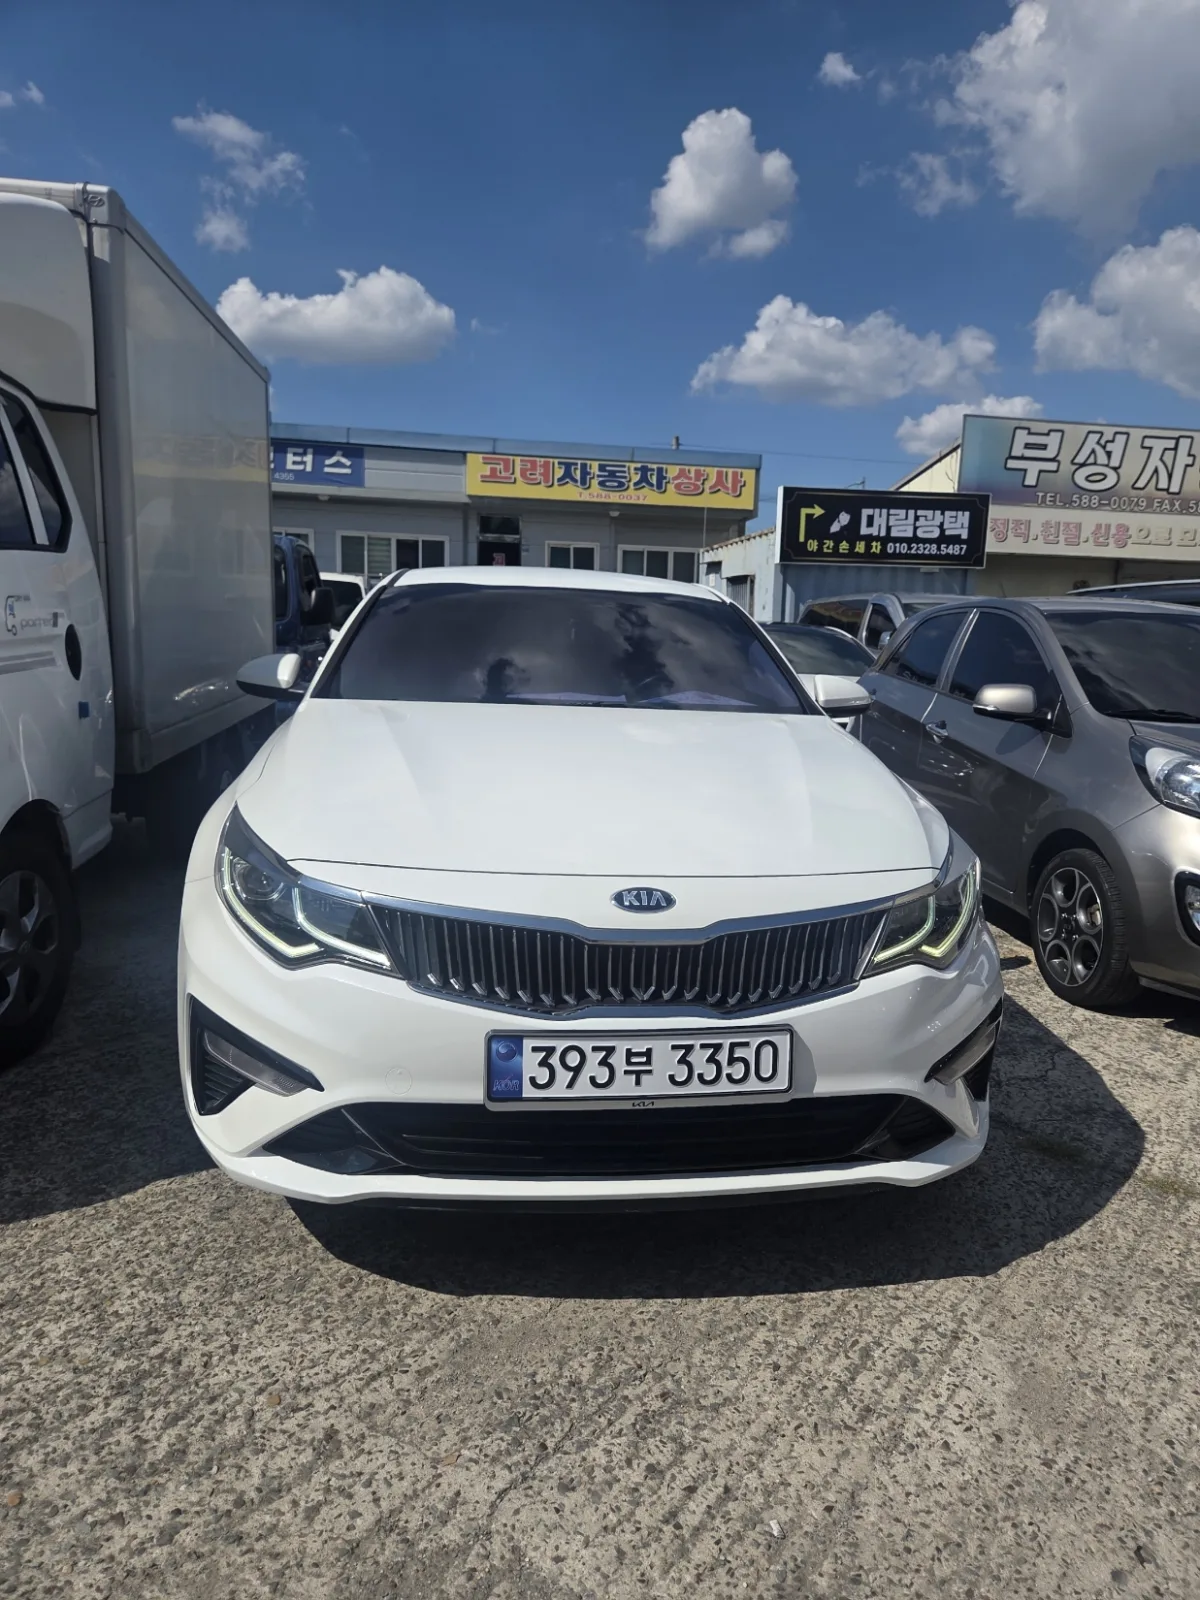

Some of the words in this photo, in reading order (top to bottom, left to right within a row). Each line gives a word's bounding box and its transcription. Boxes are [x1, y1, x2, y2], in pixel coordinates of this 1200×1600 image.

[271, 447, 352, 474] 터스
[1005, 427, 1200, 495] 부성자
[480, 455, 747, 497] 고려자동차상사
[1036, 492, 1146, 510] TEL.588-0079
[860, 508, 970, 539] 대림광택
[887, 542, 967, 555] 010.2328.5487
[621, 890, 667, 906] KIA
[528, 1044, 653, 1090] 393부
[667, 1039, 779, 1087] 3350
